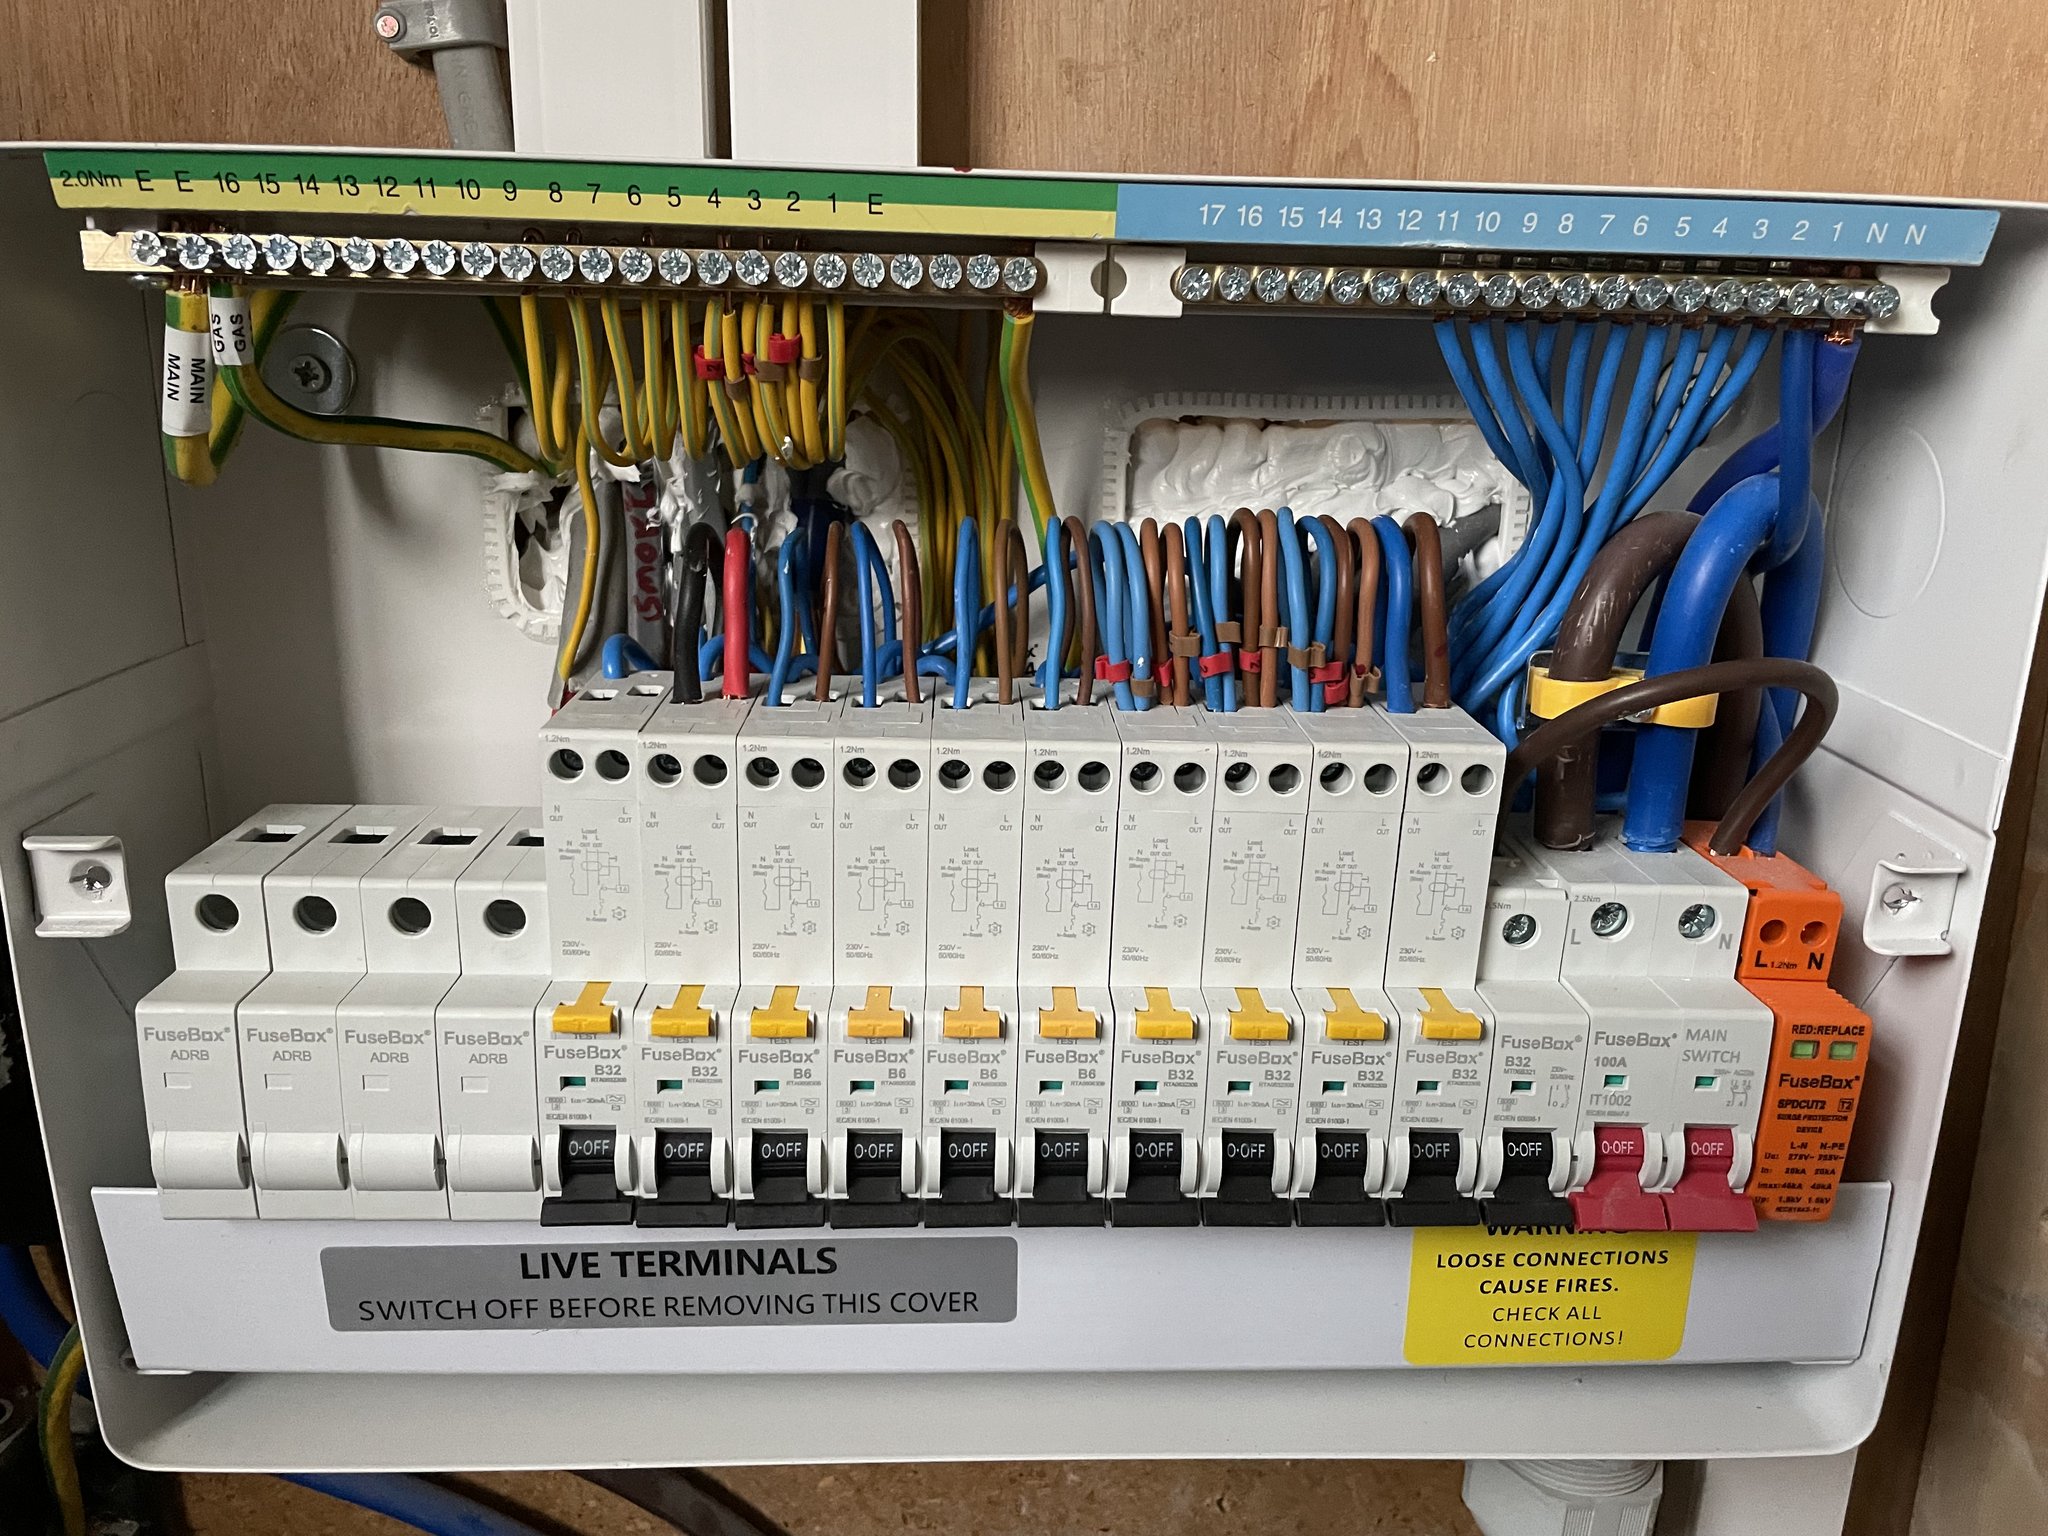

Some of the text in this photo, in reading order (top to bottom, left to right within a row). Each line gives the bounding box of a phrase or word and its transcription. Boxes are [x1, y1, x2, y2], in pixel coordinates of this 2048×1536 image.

[60, 171, 883, 215] 2.0Nm E E 16 15 14 13 12 11 10 9 8 7 6 5 4 3 2 1 E
[1200, 204, 1926, 245] 17 16 15 14 13 12 11 10 9 8 7 6 5 4 3 2 1 N N
[212, 314, 225, 352] GAS
[230, 314, 246, 352] GAS
[167, 353, 180, 401] MAIN
[190, 359, 205, 403] MAIN
[1129, 814, 1135, 822] N
[1571, 929, 1581, 945] L
[1719, 933, 1733, 949] N
[1755, 950, 1767, 968] L
[1808, 952, 1824, 970] N
[1686, 1029, 1727, 1042] MAIN
[1792, 1025, 1865, 1036] RED:REPLACE
[171, 1050, 209, 1060] ADRB
[273, 1051, 311, 1061] ADRB
[370, 1052, 409, 1063] ADRB
[469, 1053, 507, 1064] ADRB
[1682, 1050, 1740, 1063] SWITCH
[1505, 1056, 1531, 1067] B32
[1594, 1056, 1627, 1067] 100A
[595, 1065, 621, 1075] B32
[692, 1066, 718, 1077] B32
[794, 1068, 811, 1079] B6
[888, 1068, 906, 1079] B6
[980, 1069, 997, 1079] B6
[1079, 1069, 1096, 1079] B6
[1168, 1069, 1194, 1080] B32
[1265, 1070, 1291, 1081] B32
[1358, 1071, 1383, 1081] B32
[1452, 1069, 1477, 1079] B32
[1590, 1094, 1631, 1107] IT1002
[521, 1247, 837, 1279] LIVE TERMINALS
[1437, 1250, 1668, 1268] LOOSE CONNECTIONS
[1480, 1278, 1618, 1294] CAUSE FIRES.
[359, 1292, 978, 1321] SWITCH OFF BEFORE REMOVING THIS COVER
[1493, 1306, 1601, 1321] CHECK ALL
[1465, 1331, 1622, 1348] CONNECTIONS!
